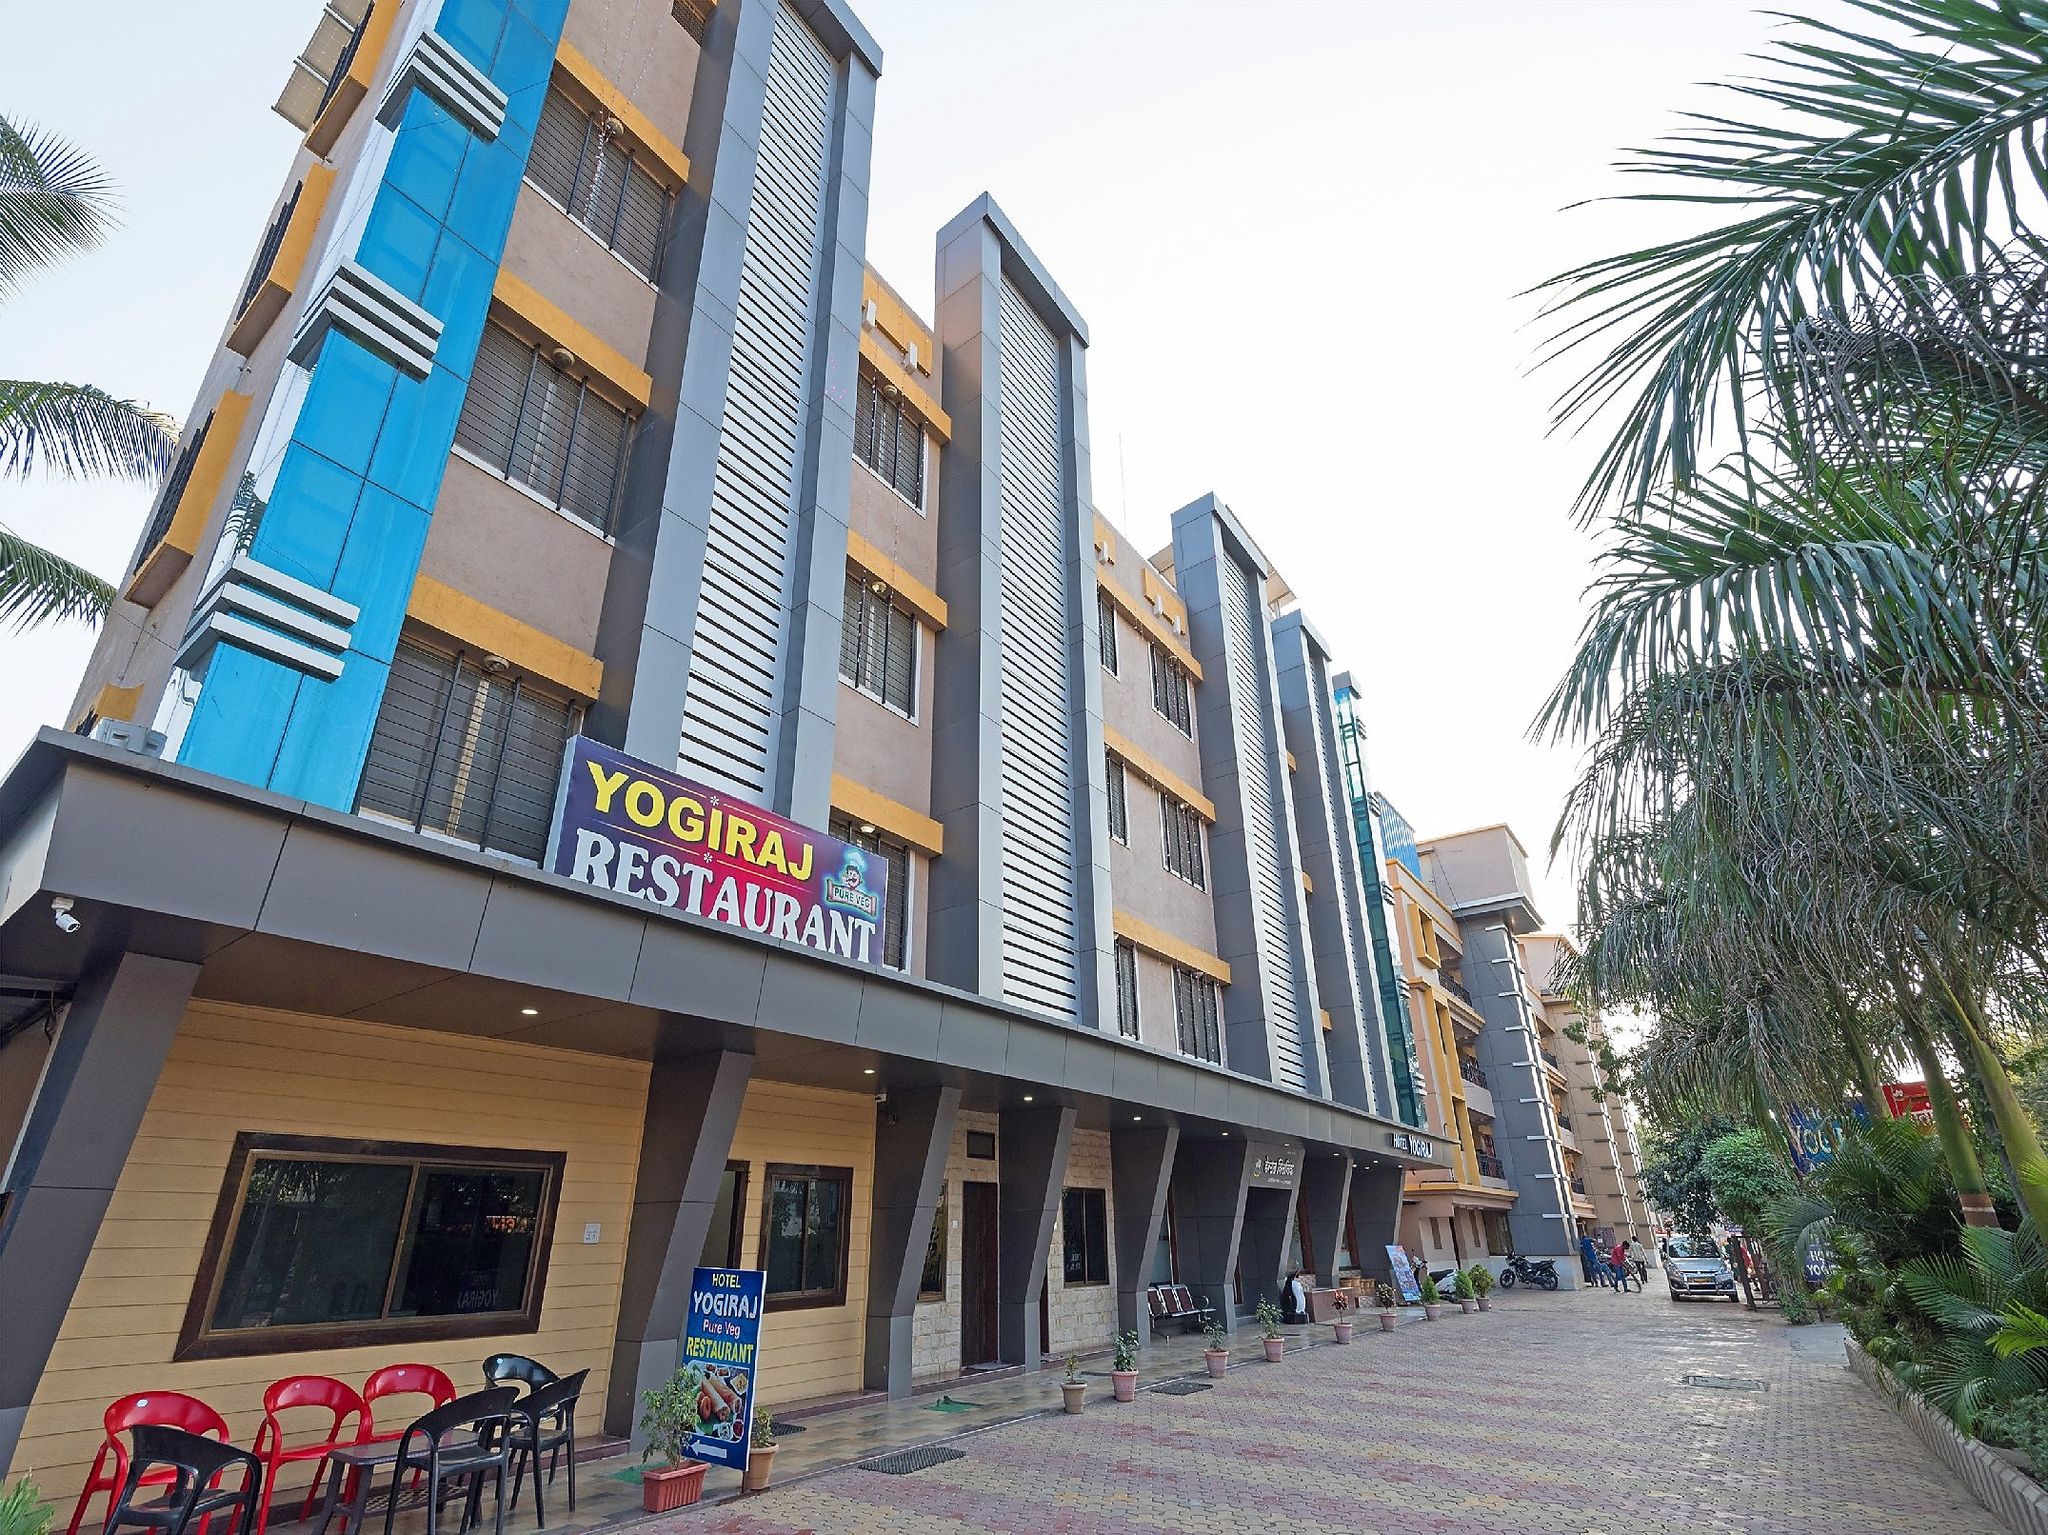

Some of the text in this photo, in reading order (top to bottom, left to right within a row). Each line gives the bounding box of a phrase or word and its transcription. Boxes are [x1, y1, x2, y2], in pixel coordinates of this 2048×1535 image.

[586, 760, 813, 881] YOGIRAJ
[569, 828, 877, 964] RESTAURANT
[834, 887, 870, 908] PURE VEG
[712, 1273, 741, 1288] HOTEL
[694, 1291, 758, 1319] YOGIRAJ
[703, 1319, 740, 1339] Pure Veg
[686, 1336, 754, 1364] RESTAURANT
